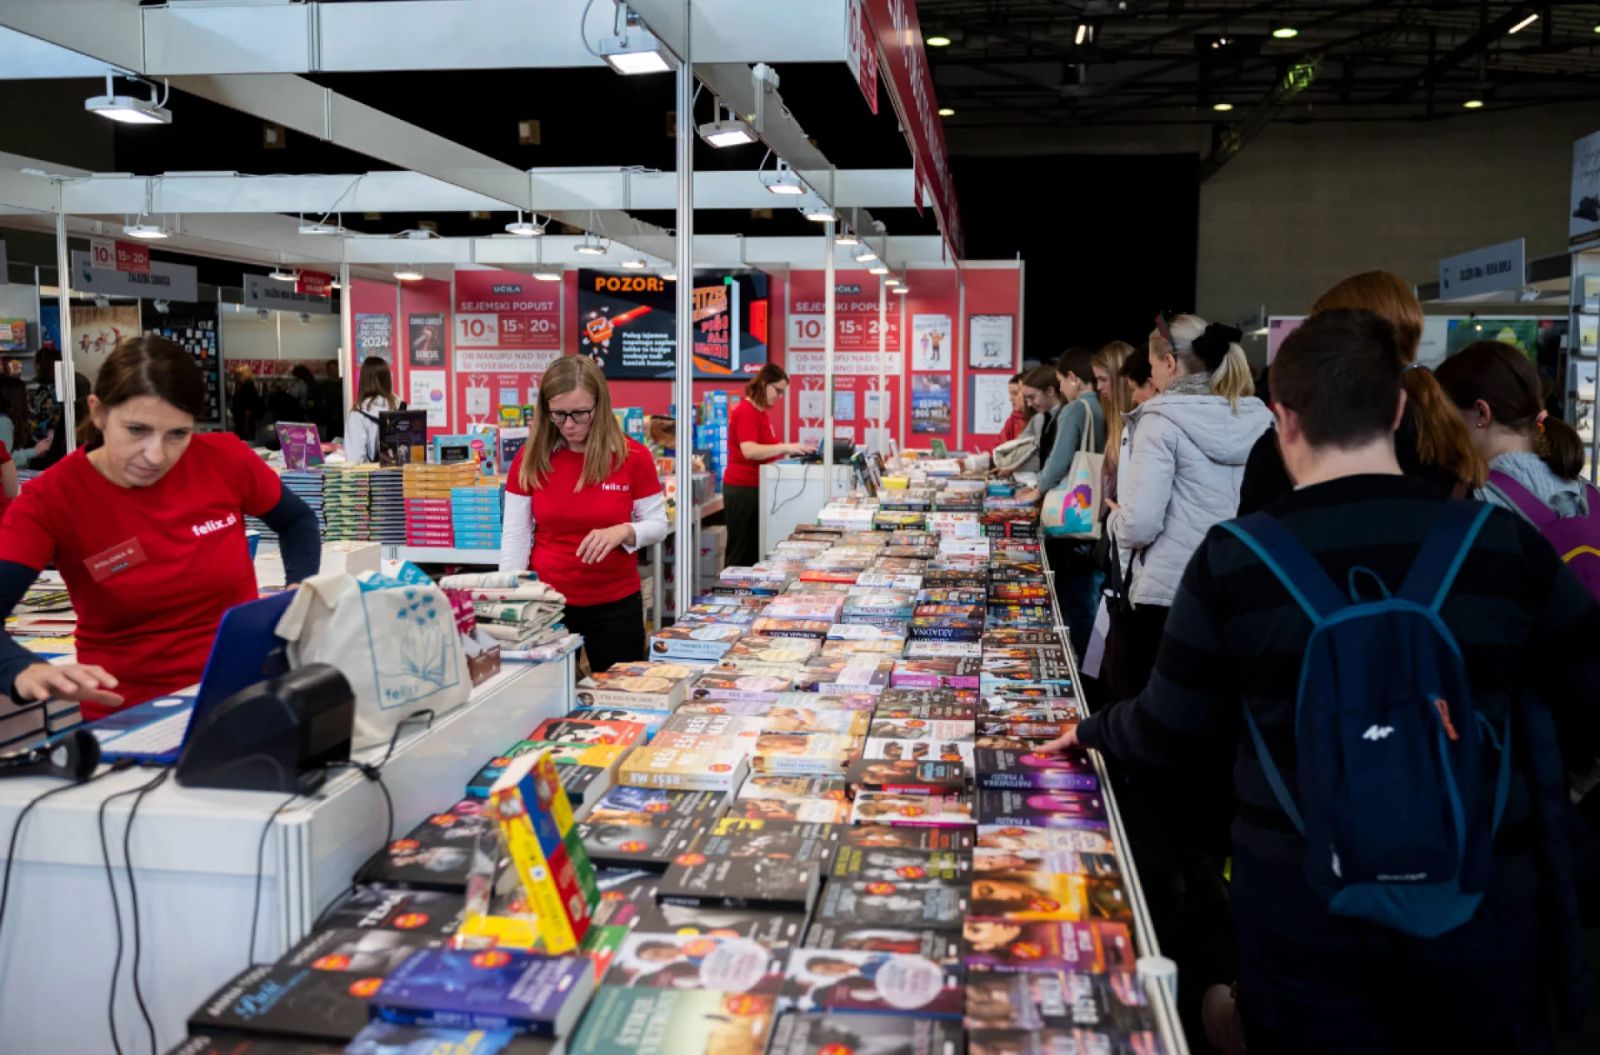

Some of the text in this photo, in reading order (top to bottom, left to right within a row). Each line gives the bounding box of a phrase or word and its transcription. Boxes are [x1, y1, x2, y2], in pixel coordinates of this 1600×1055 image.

[595, 276, 664, 292] POZOR:
[460, 301, 554, 311] SEJEMSKI POPUST
[796, 302, 894, 312] SEJEKI POPUT
[361, 337, 389, 347] 2024
[602, 483, 630, 492] felix.si
[192, 513, 236, 537] felix.si
